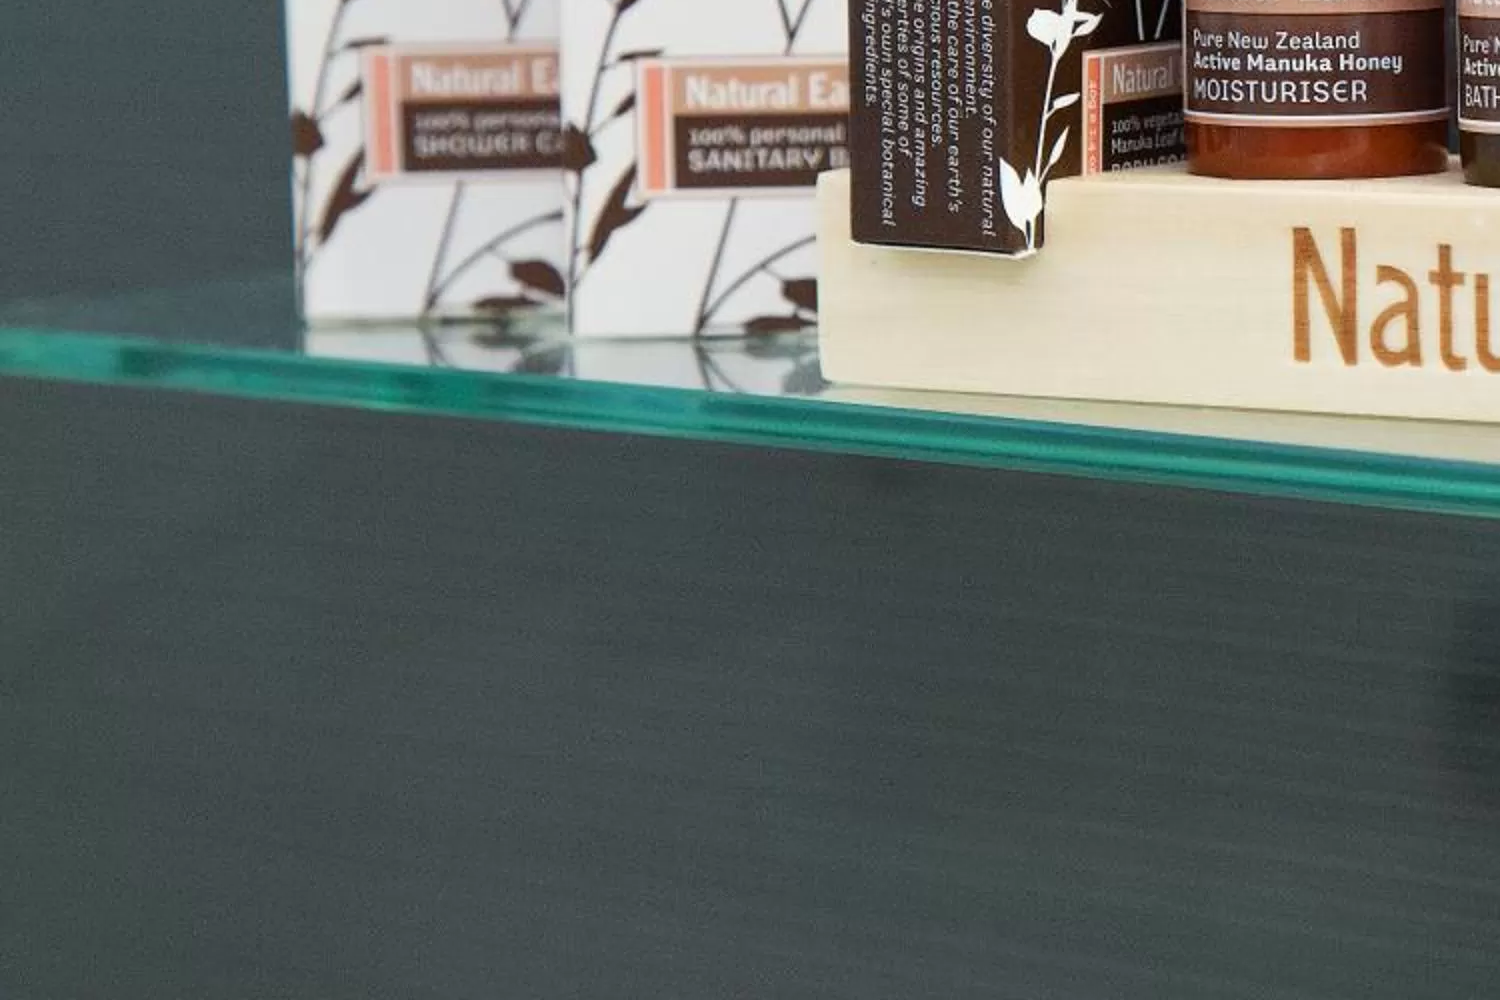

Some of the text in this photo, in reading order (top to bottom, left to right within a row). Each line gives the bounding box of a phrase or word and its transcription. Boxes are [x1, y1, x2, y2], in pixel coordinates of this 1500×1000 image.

[947, 0, 961, 31] the
[881, 23, 893, 63] own
[910, 17, 928, 83] origins
[1193, 28, 1360, 49] Pure New Zealand
[1464, 34, 1490, 53] Pure
[897, 58, 912, 80] of
[948, 35, 959, 80] care
[979, 15, 996, 99] diversity
[1193, 52, 1402, 74] Active Manuka Honey
[411, 61, 518, 94] Natural
[685, 73, 798, 109] Natural
[1113, 56, 1173, 95] Natural
[1194, 78, 1367, 102] MOISTURISER
[879, 68, 895, 134] special
[897, 83, 909, 131] some
[913, 88, 928, 125] and
[931, 49, 943, 147] resources.
[948, 83, 963, 106] of
[948, 108, 959, 140] our
[981, 104, 996, 127] of
[413, 132, 530, 157] SHOWER
[687, 122, 846, 148] 100% personal
[898, 136, 912, 159] of
[981, 130, 993, 162] our
[687, 147, 824, 173] SANITARY
[912, 128, 928, 207] amazing
[881, 138, 896, 227] botanical
[948, 145, 963, 213] earth's
[981, 166, 996, 237] natural
